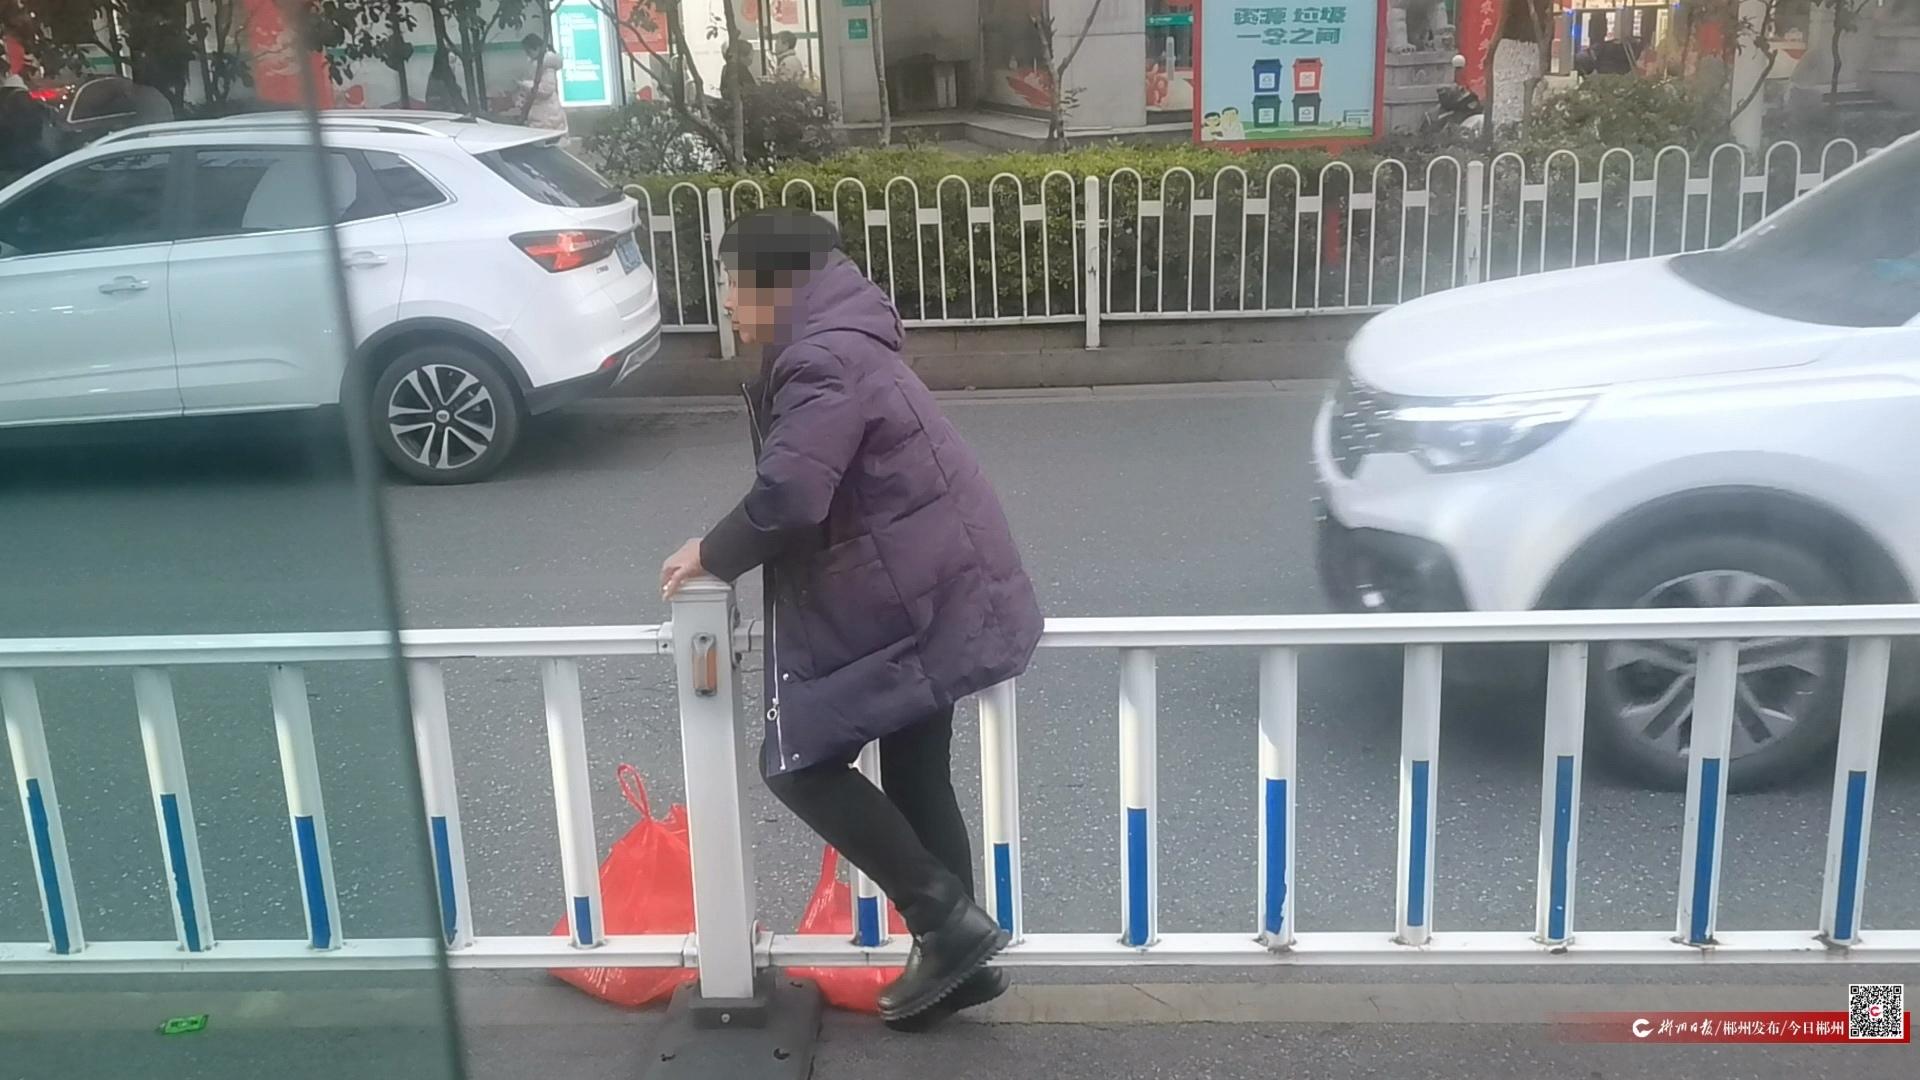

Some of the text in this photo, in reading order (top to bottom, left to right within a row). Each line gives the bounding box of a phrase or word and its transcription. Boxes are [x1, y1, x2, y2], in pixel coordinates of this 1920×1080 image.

[1233, 6, 1346, 25] 资源 垃圾
[1236, 27, 1341, 45] 一念之间
